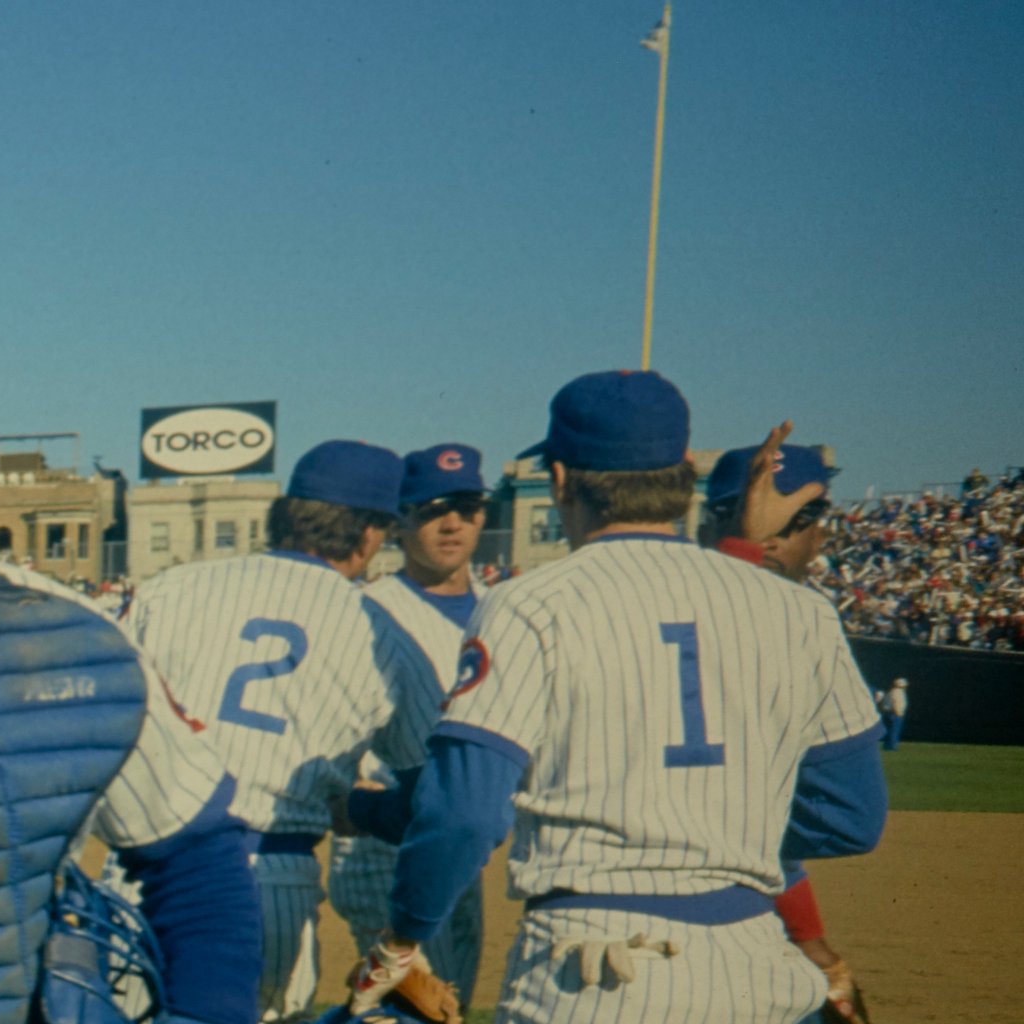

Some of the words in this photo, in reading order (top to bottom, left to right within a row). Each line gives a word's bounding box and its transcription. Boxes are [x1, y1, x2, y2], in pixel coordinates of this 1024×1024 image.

[151, 428, 266, 453] TORCO
[437, 450, 464, 471] C
[217, 616, 308, 736] 2
[658, 621, 726, 769] 1
